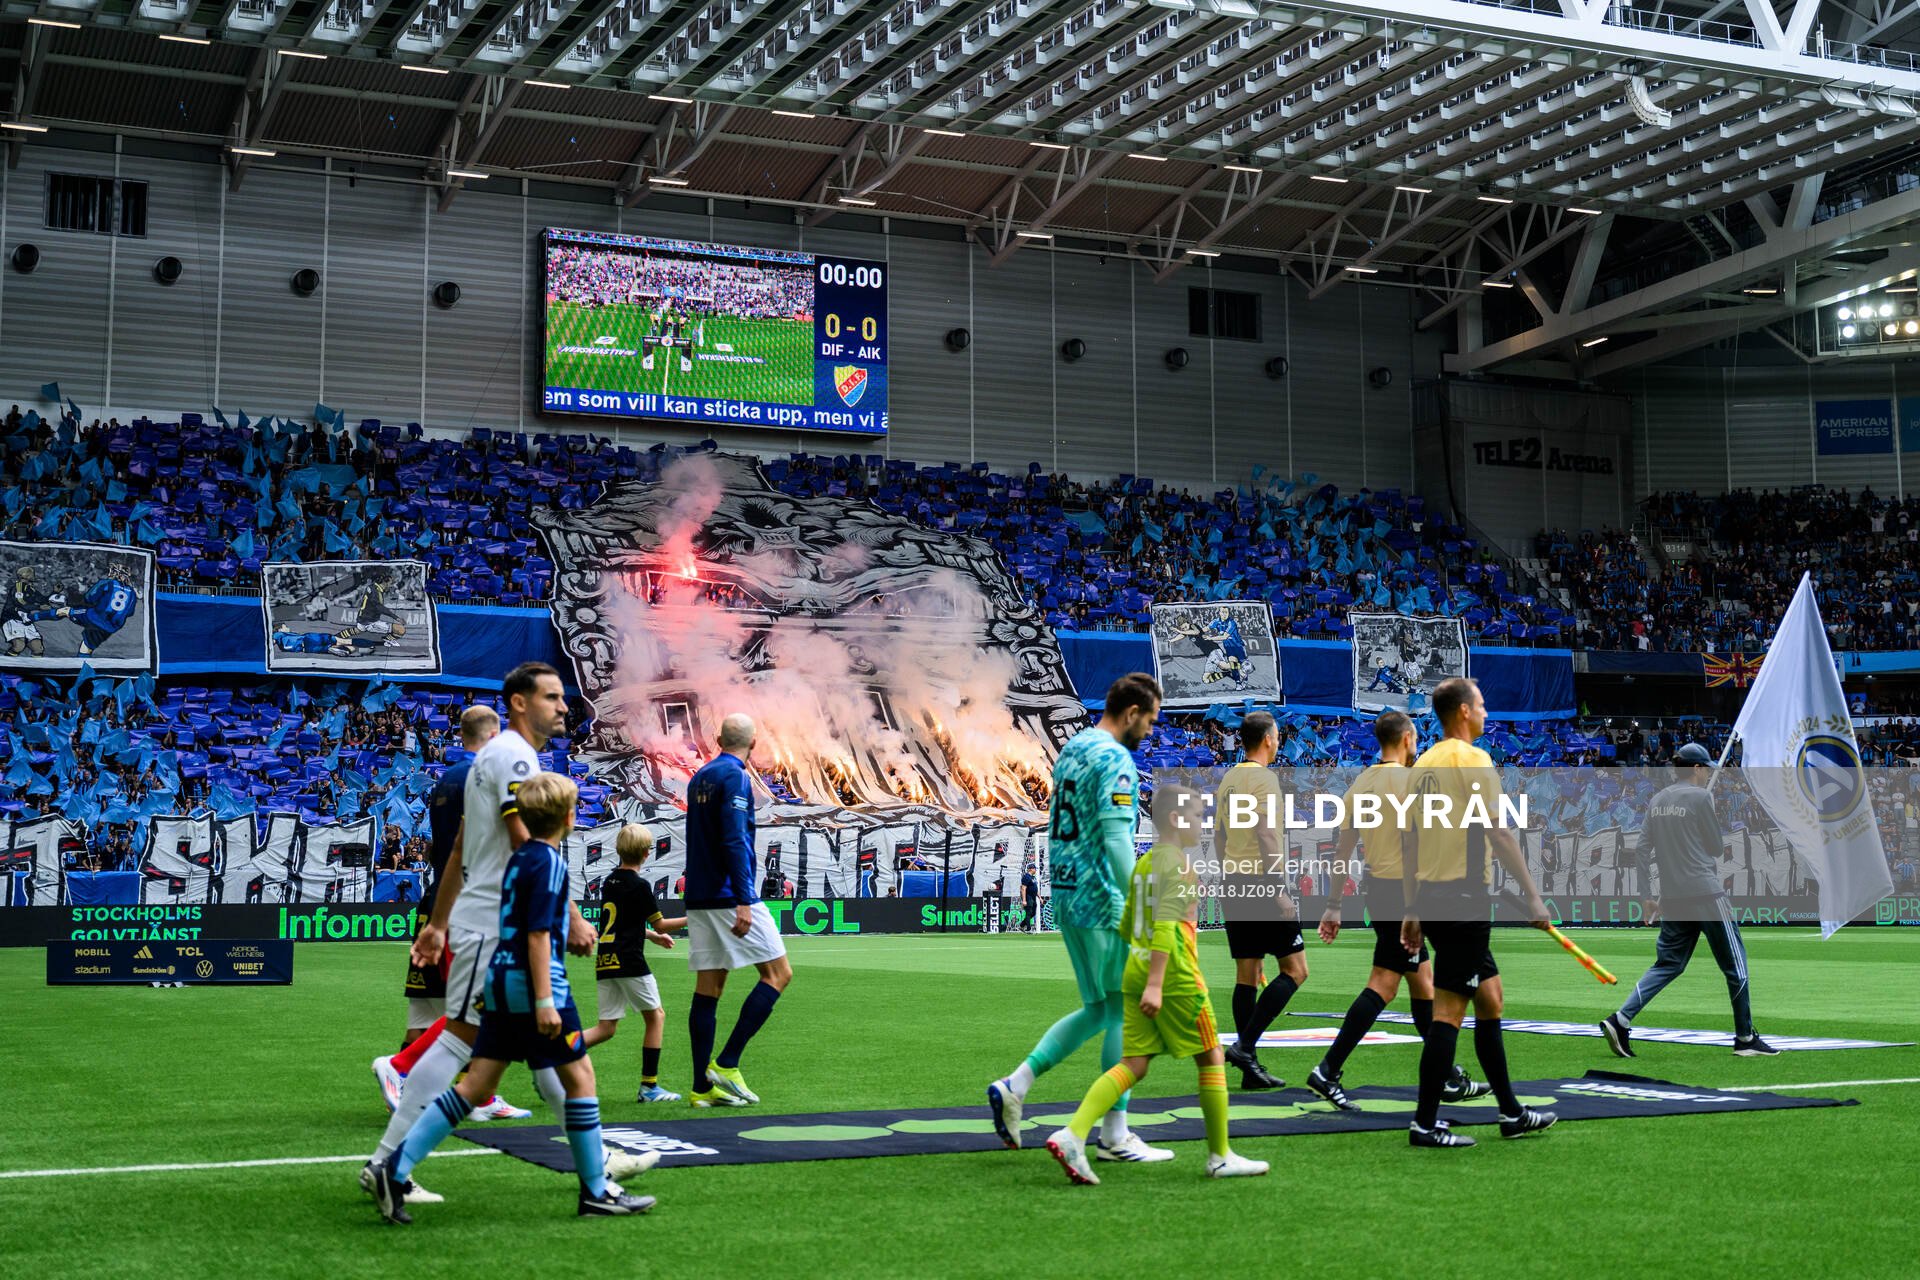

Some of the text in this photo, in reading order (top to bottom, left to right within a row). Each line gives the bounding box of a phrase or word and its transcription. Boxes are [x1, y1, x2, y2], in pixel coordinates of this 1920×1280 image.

[820, 263, 882, 289] 00:00
[825, 313, 840, 338] 0
[862, 316, 877, 341] 0
[822, 342, 844, 356] DIF
[857, 346, 881, 359] AIK
[578, 393, 621, 409] som
[627, 395, 656, 411] vill
[664, 396, 697, 414] kan
[704, 400, 761, 419] sticka
[767, 407, 807, 425] upp,
[814, 411, 853, 426] men
[859, 412, 874, 427] vi
[1820, 417, 1888, 428] AMERICAN
[1830, 427, 1889, 438] EXPRESS
[1473, 437, 1614, 474] TELE2 Arena
[111, 590, 129, 611] 8
[72, 906, 202, 921] STOCKHOLMS
[765, 901, 860, 934] TCL
[990, 896, 1000, 933] SELECT
[1571, 901, 1643, 922] ELED
[1732, 907, 1790, 924] TARK
[279, 907, 418, 939] Infomet
[599, 902, 617, 944] 2
[75, 948, 111, 957] MOBILL
[176, 947, 204, 957] TCL
[75, 965, 111, 974] stadium
[133, 965, 167, 974] Sundström
[233, 962, 264, 971] UNIBET
